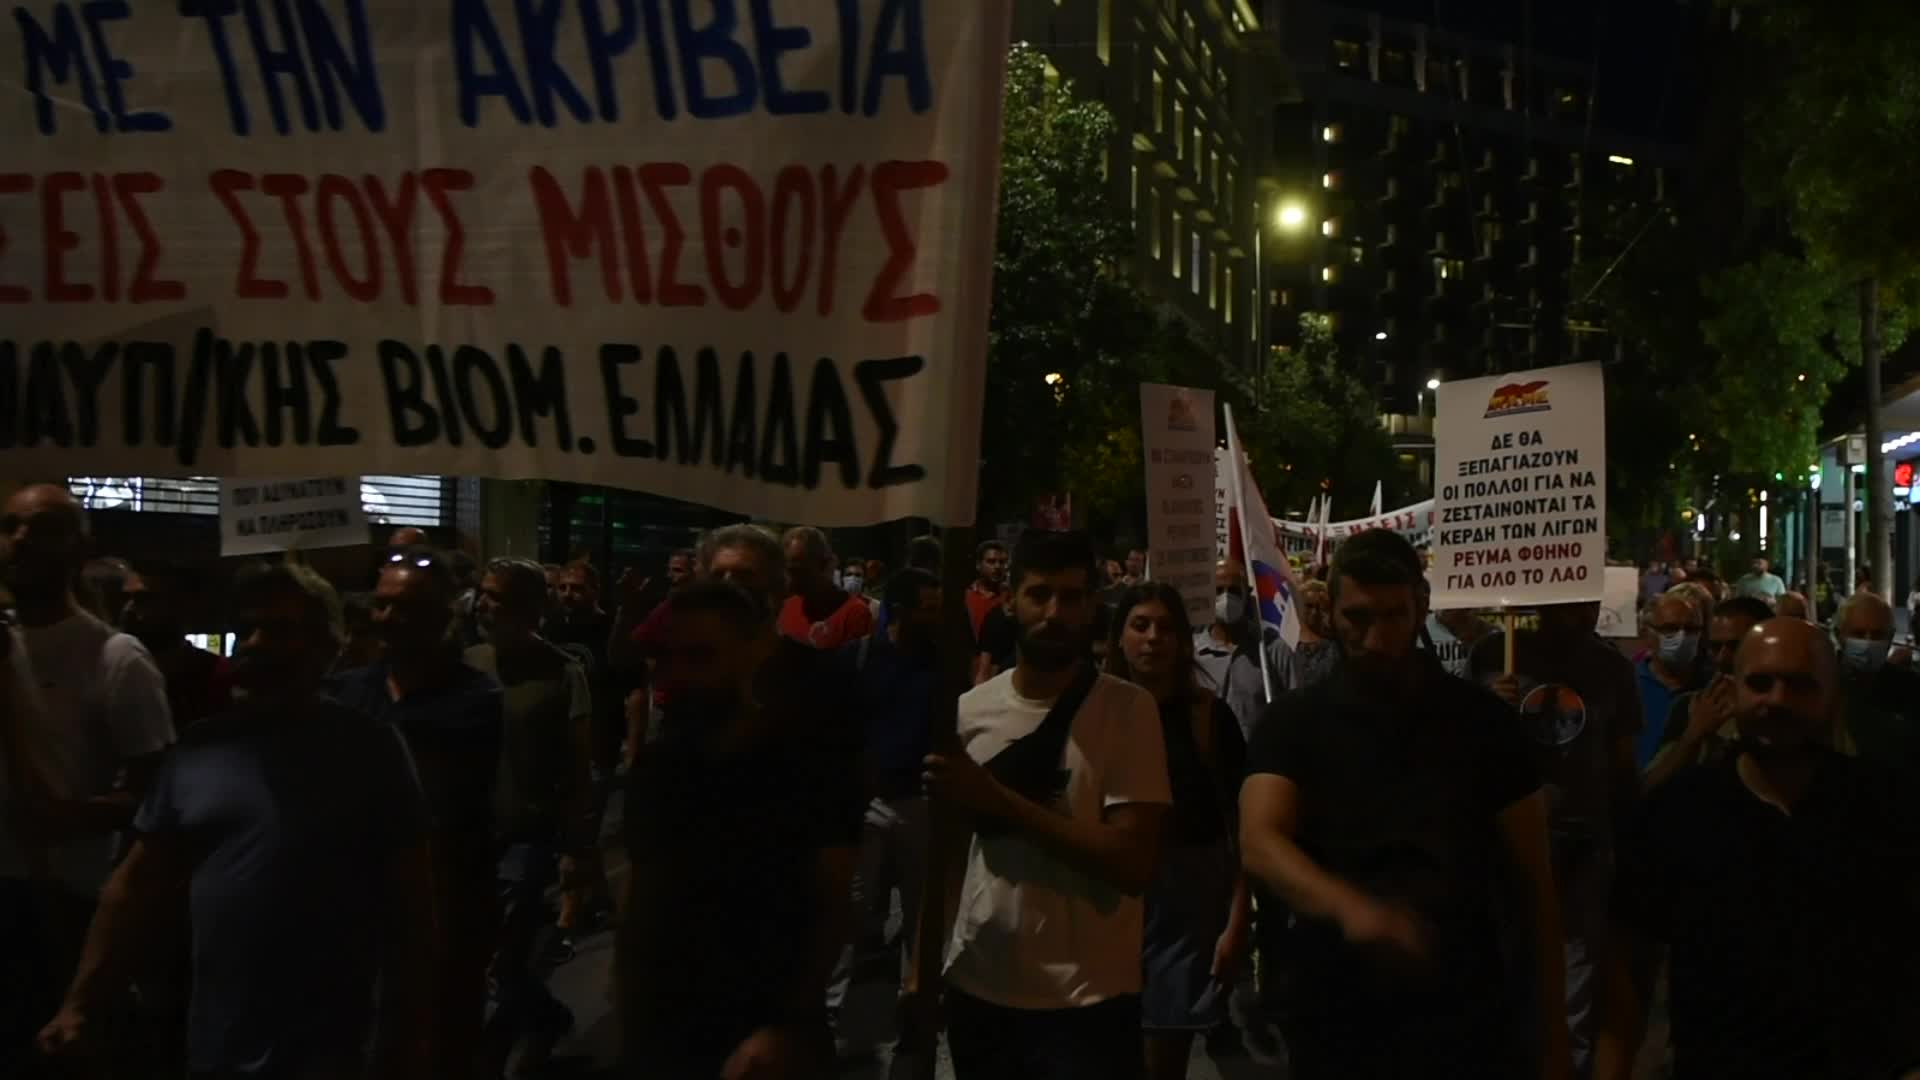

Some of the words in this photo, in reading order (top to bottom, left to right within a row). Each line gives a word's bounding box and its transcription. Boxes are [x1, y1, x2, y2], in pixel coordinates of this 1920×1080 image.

[14, 1, 172, 134] ΜΕ
[180, 0, 385, 136] ΤΗΝ
[452, 0, 931, 128] ΑΚΡΙΒΕΙΑ
[209, 169, 496, 306] ΣΤΟΥΣ
[530, 161, 949, 322] ΜΙΣΘΟΥΣ
[379, 340, 595, 455] ΒΙΟΜ.
[601, 344, 924, 490] ΕΛΛΑΔΑΣ
[1492, 432, 1513, 450] ΔΕ
[1519, 430, 1543, 446] ΘΑ
[1458, 449, 1578, 476] ΞΕΠΑΓΙΑΖΟΥΝ
[1443, 485, 1459, 500] ΟΙ
[1464, 476, 1528, 498] ΠΟΛΛΟΙ
[1535, 473, 1564, 491] ΓΙΑ
[1570, 471, 1596, 488] ΝΑ
[1442, 496, 1566, 523] ΖΕΣΤΑΙΝΟΝΤΑΙ
[1572, 494, 1596, 511] ΤΑ
[1441, 526, 1496, 546] ΚΕΡΔΗ
[1502, 522, 1536, 541] ΤΩΝ
[1542, 517, 1598, 537] ΛΙΓΩΝ
[1454, 549, 1512, 567] ΡΕΥΜΑ
[1518, 542, 1582, 561] ΦΘΗΝΟ
[1447, 574, 1475, 590] ΓΙΑ
[1481, 570, 1516, 588] ΟΛΟ
[1522, 568, 1544, 585] ΤΟ
[1550, 565, 1588, 583] ΛΑΟ
